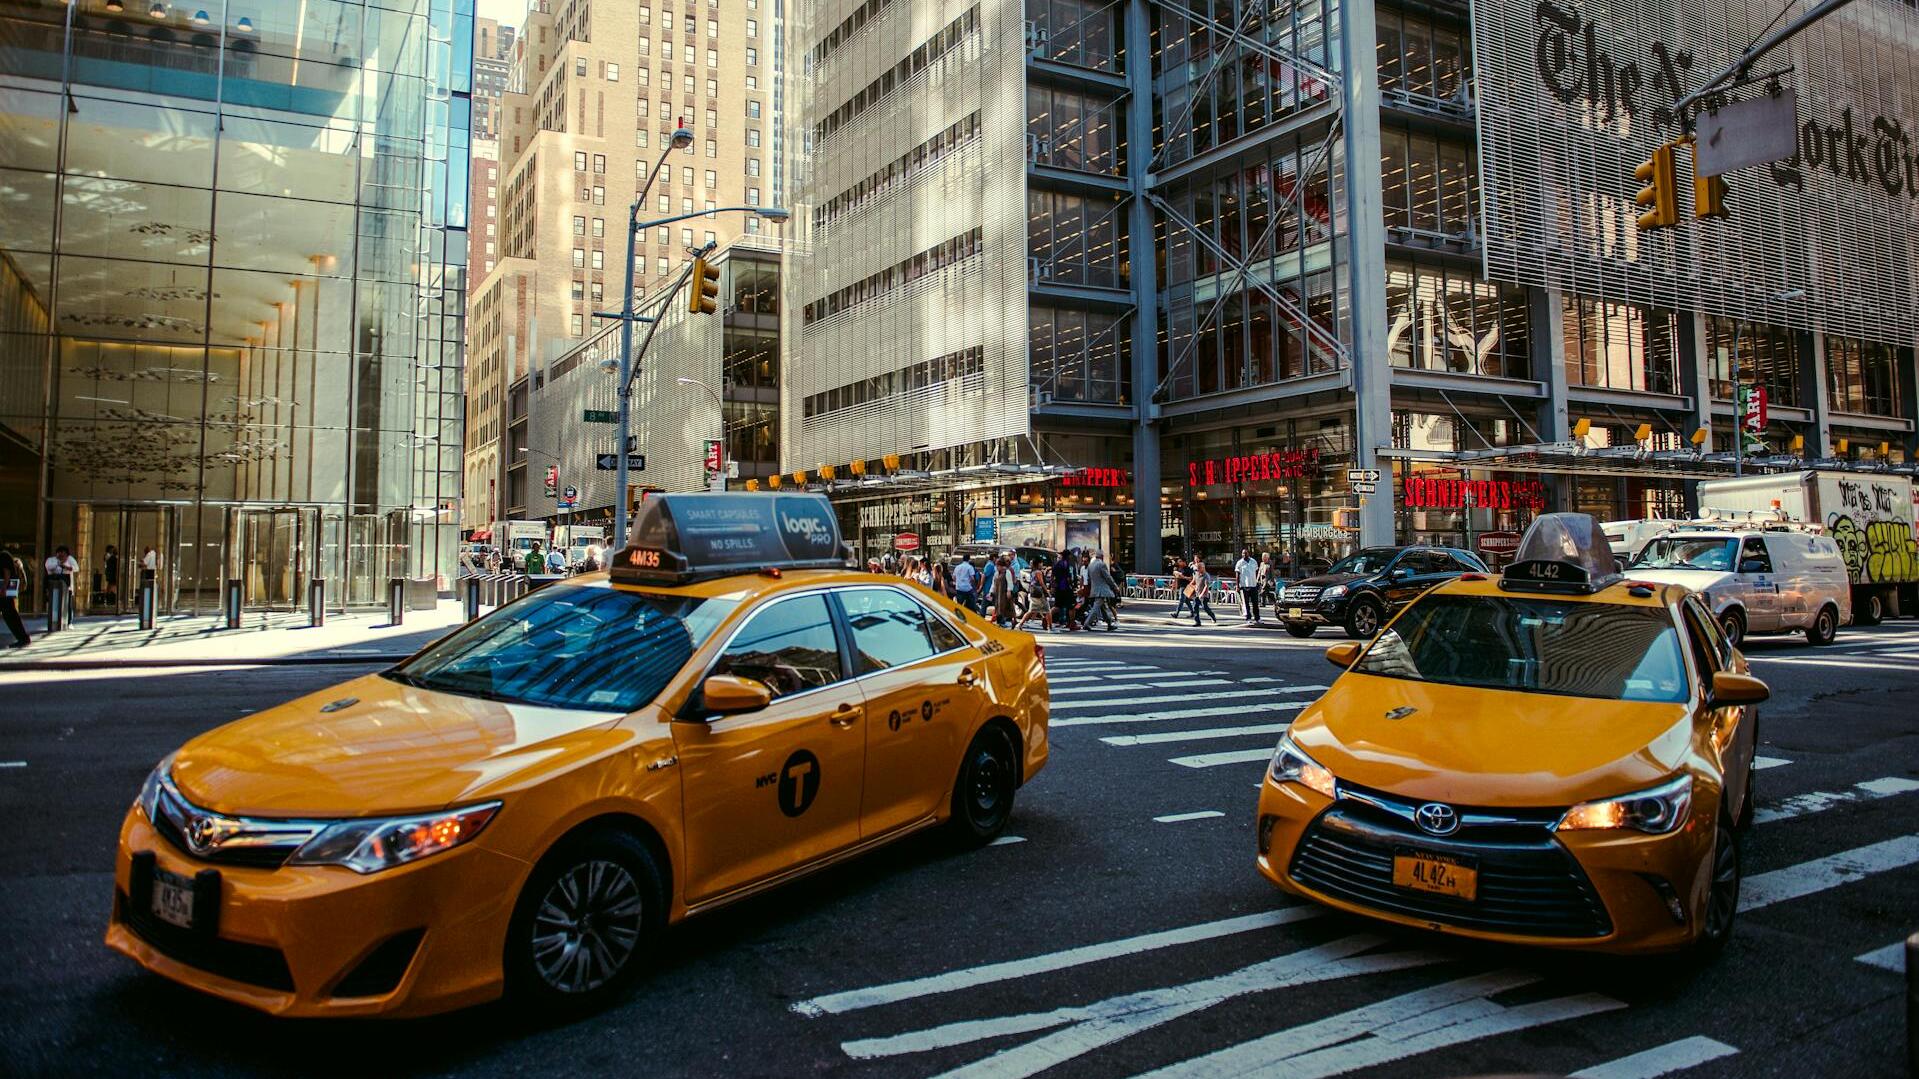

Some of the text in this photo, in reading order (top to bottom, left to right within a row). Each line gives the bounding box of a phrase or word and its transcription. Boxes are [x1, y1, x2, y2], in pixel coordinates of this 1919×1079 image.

[1535, 2, 1642, 124] The
[1746, 388, 1761, 430] ART
[686, 510, 715, 520] SMART
[780, 511, 827, 540] logic.
[710, 540, 723, 550] NO
[811, 533, 831, 545] PRO
[629, 550, 660, 568] 4M35
[1529, 562, 1559, 579] 4L42
[979, 639, 1005, 656] 4M35
[756, 761, 812, 808] NYC T
